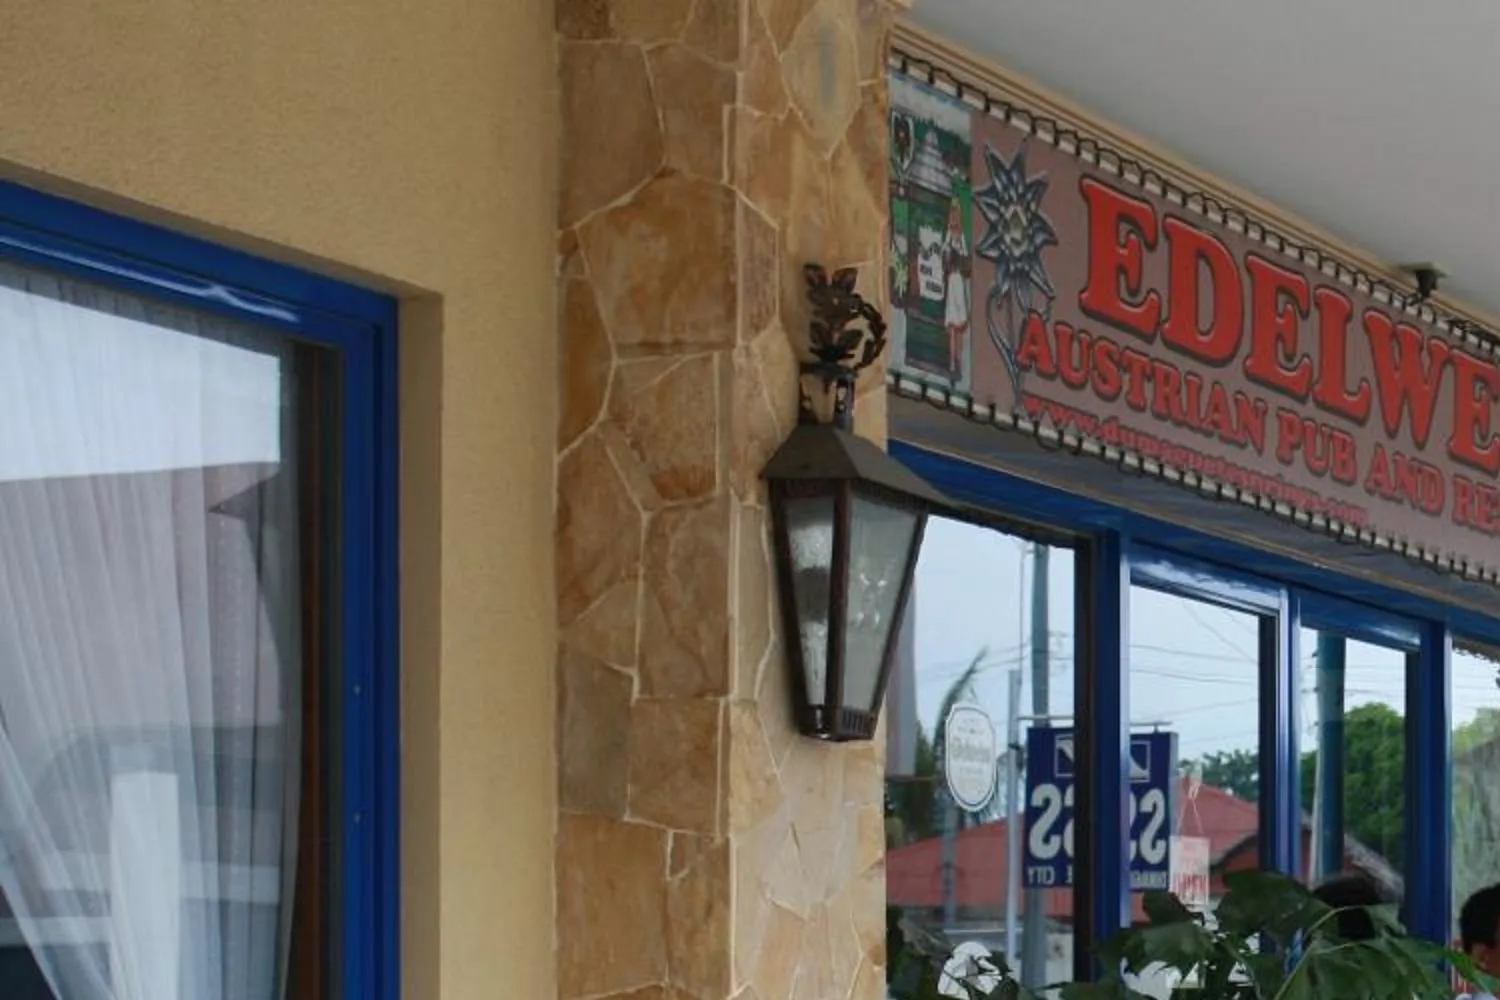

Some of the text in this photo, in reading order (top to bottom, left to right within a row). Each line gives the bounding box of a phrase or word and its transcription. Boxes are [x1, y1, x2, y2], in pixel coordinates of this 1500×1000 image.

[1016, 313, 1267, 451] AUSTRIAN
[1276, 407, 1358, 485] PUB
[1366, 449, 1446, 517] AND
